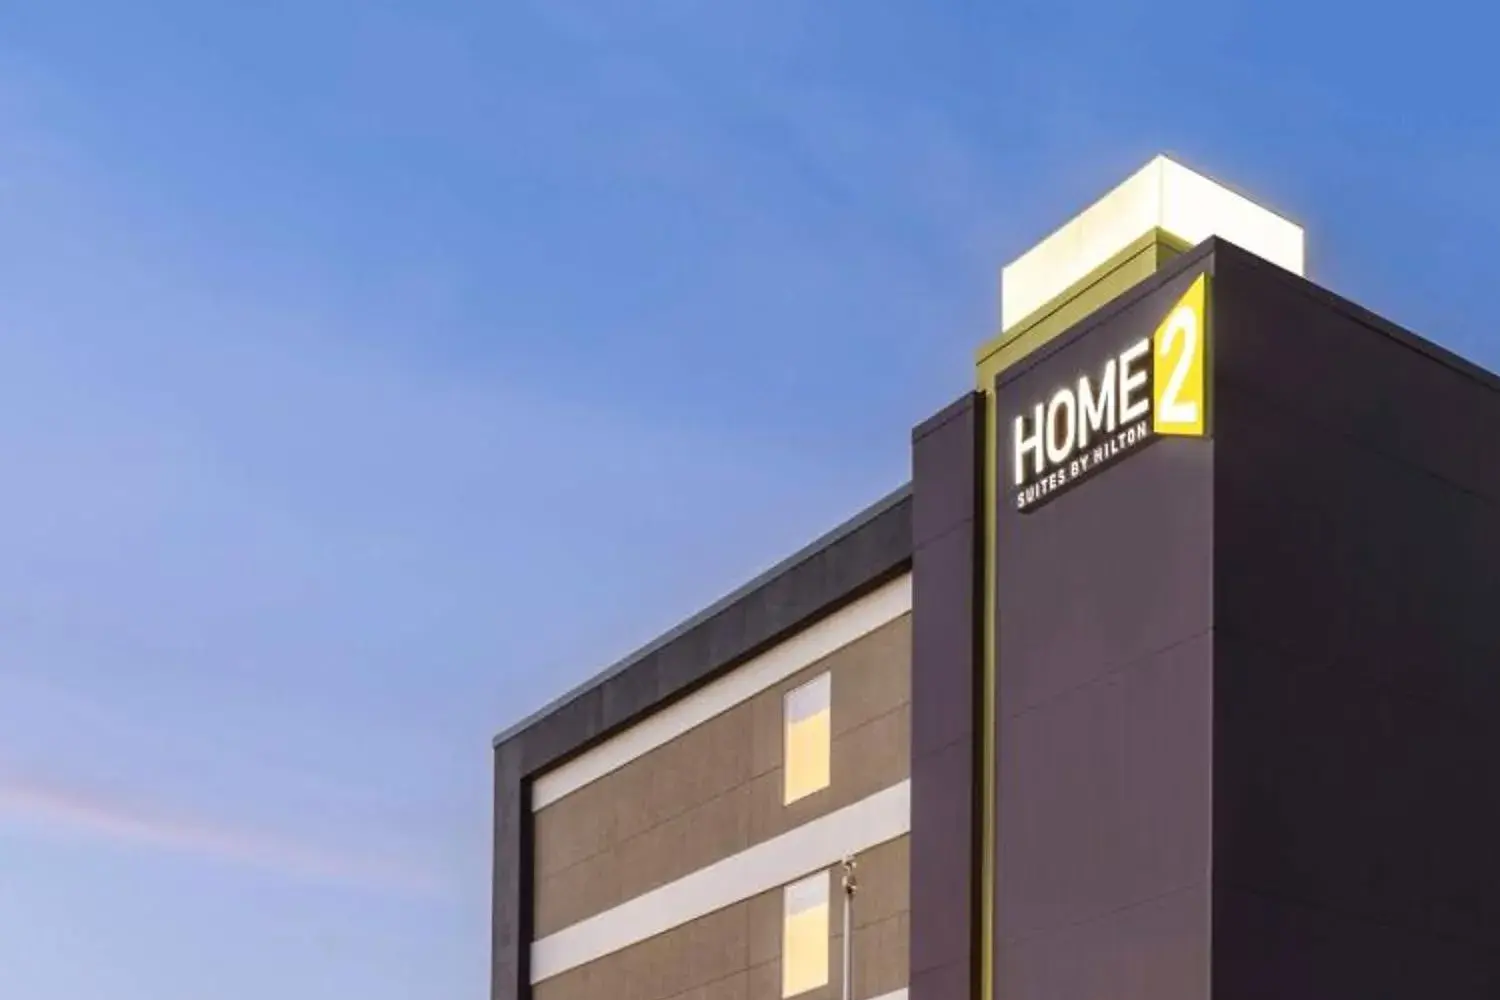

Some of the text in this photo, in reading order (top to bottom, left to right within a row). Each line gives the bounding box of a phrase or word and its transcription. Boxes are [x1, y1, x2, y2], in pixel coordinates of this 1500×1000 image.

[1017, 420, 1148, 509] SUITES BY HILTON
